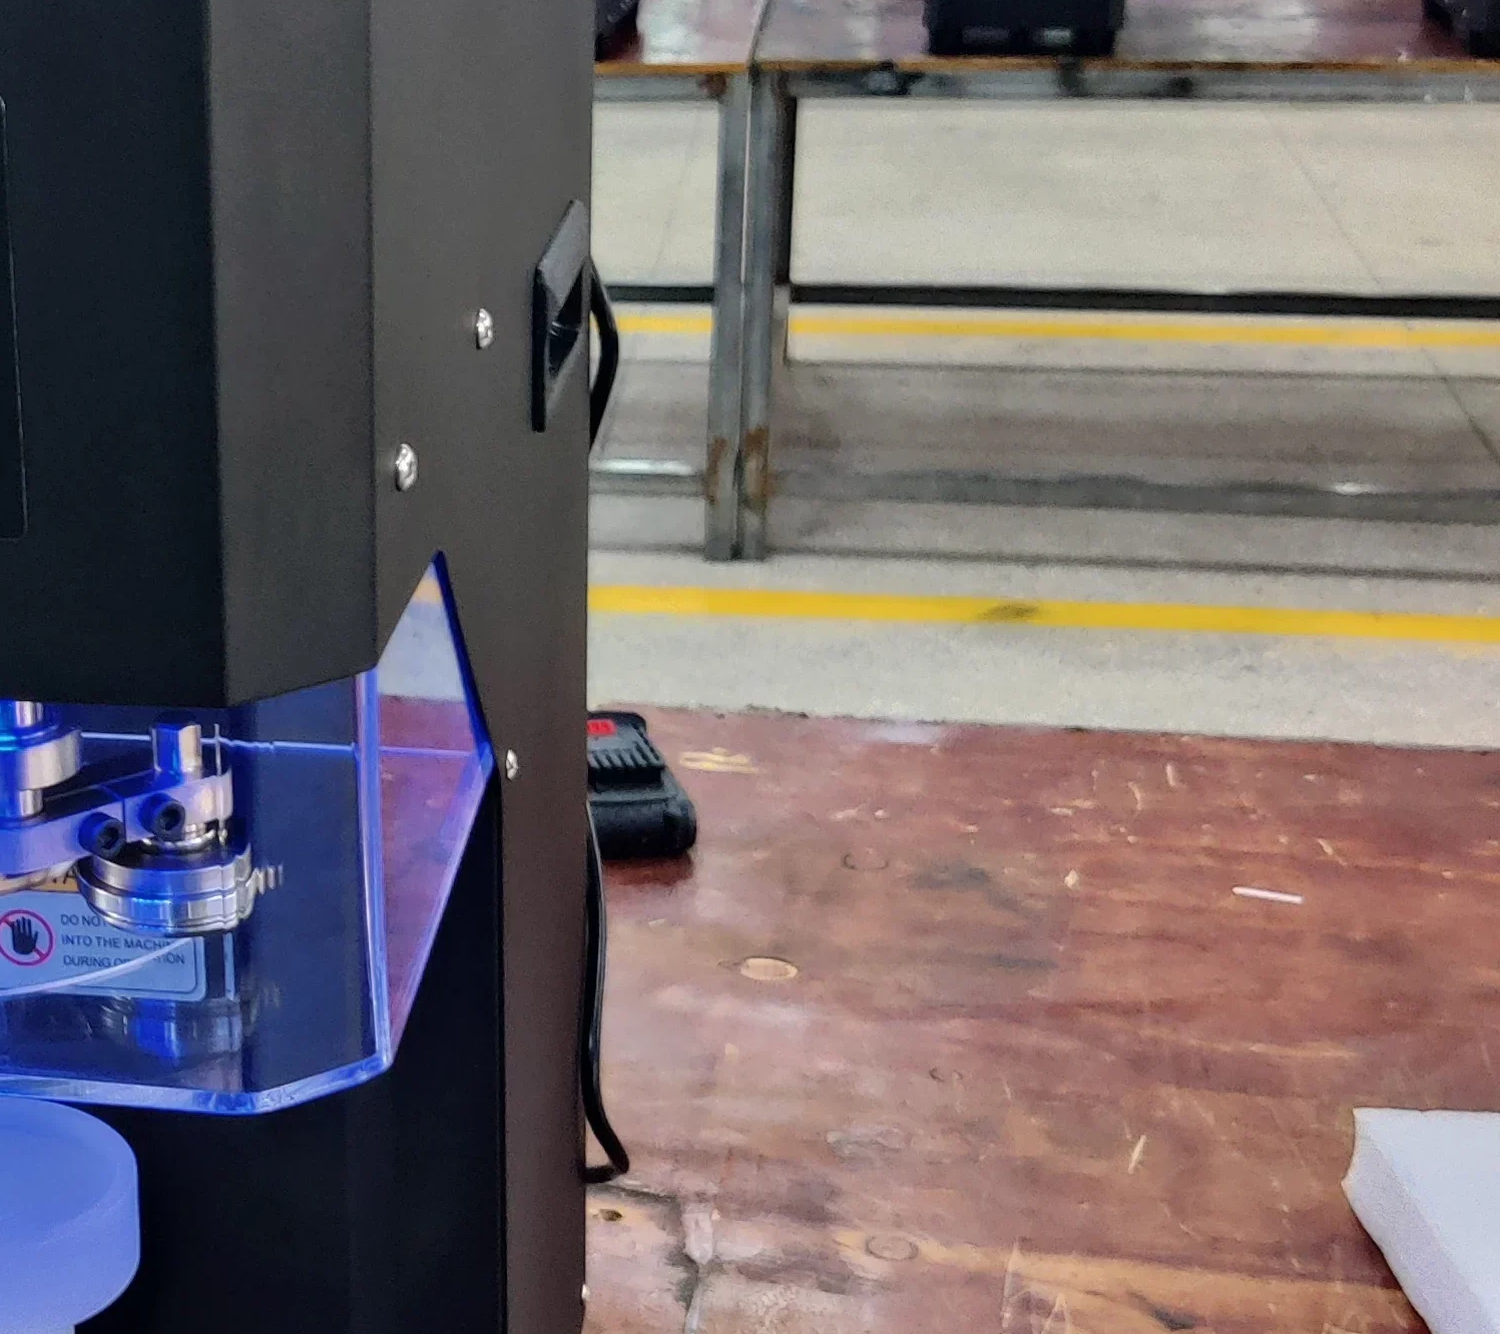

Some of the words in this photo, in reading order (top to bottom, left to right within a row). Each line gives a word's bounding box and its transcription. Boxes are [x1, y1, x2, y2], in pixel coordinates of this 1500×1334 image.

[60, 913, 79, 926] DO
[61, 934, 92, 947] INTO
[95, 936, 121, 948] THE
[63, 954, 111, 967] DURING
